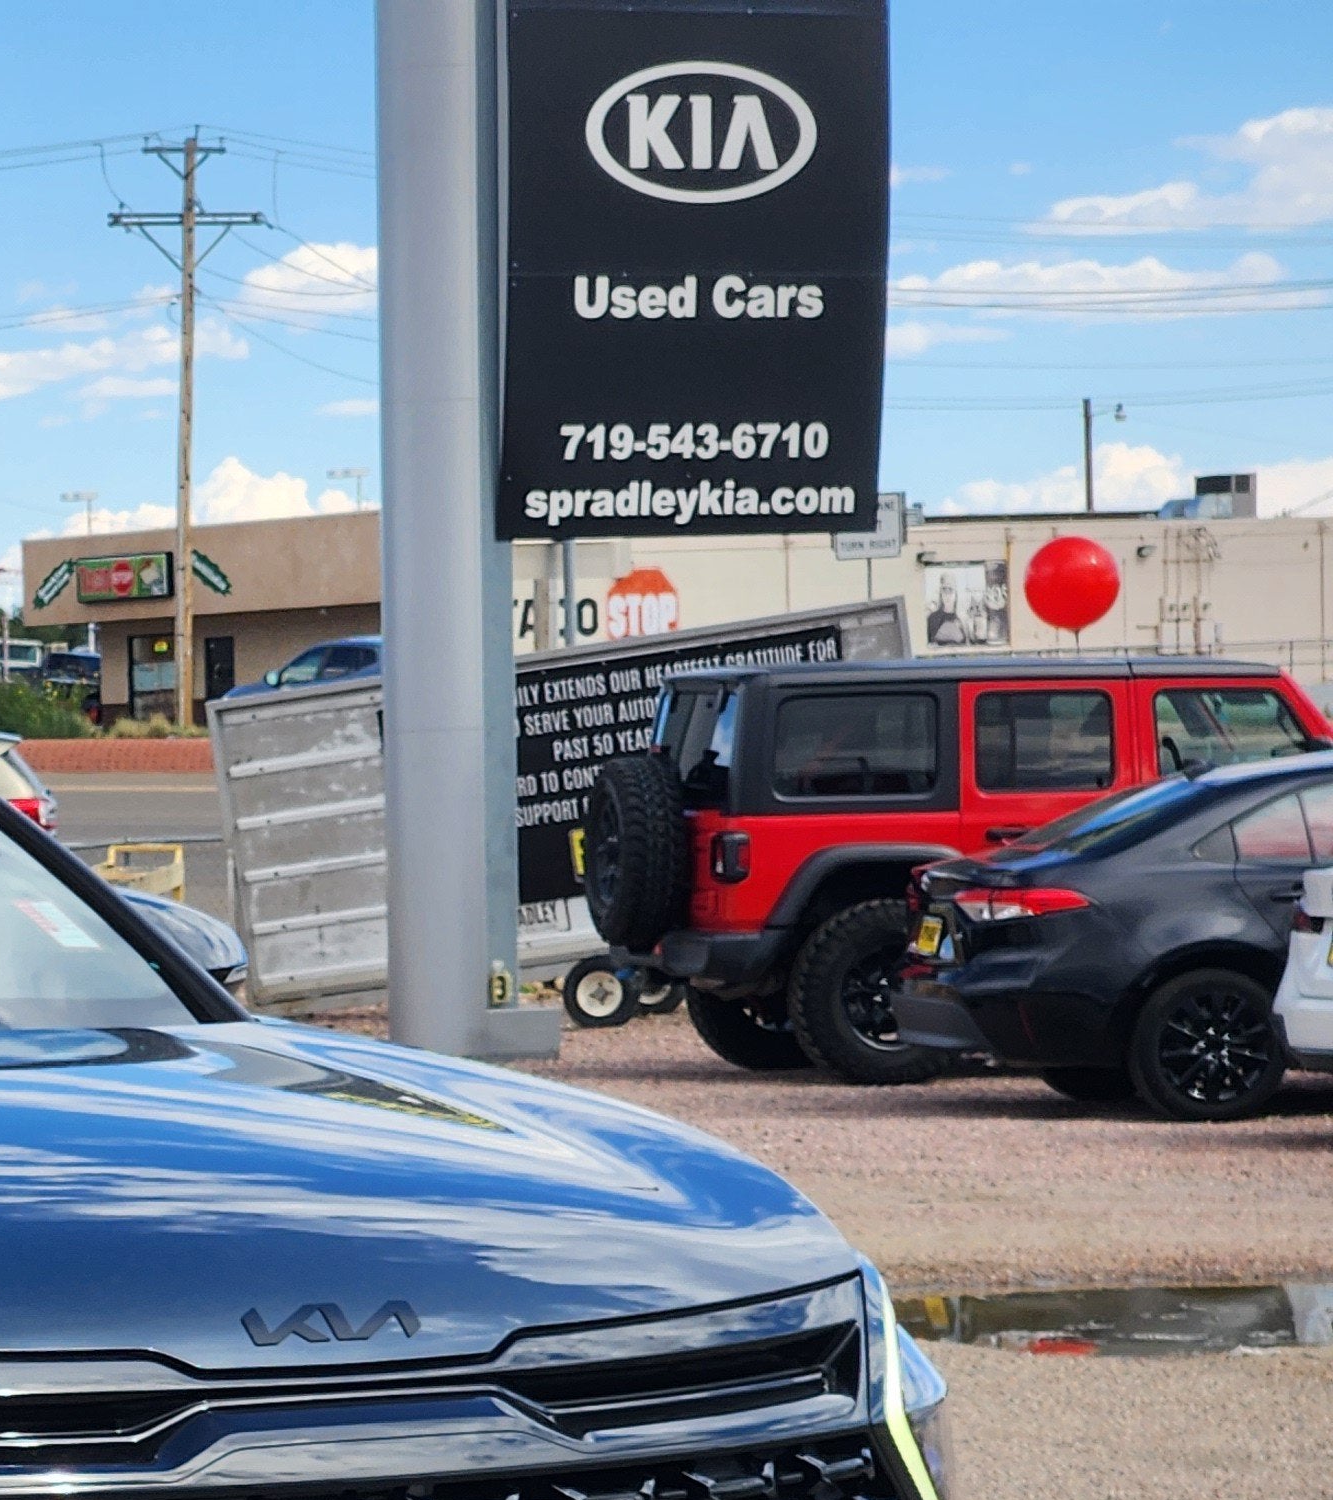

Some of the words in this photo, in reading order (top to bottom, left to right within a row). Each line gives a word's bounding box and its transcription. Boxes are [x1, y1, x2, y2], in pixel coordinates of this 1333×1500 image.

[627, 94, 779, 170] KIA
[574, 275, 697, 319] Used
[712, 275, 825, 319] Cars
[559, 423, 830, 461] 719-543-6710
[524, 480, 856, 526] spradleykia.com
[608, 593, 676, 639] STOP
[543, 673, 607, 703] EXTENDS
[609, 667, 642, 694] OUR
[808, 636, 838, 664] FOR
[523, 709, 571, 737] SERVE
[573, 702, 615, 729] YOUR
[552, 734, 590, 762] PAST
[592, 732, 615, 757] 50
[540, 770, 560, 794] TO
[515, 797, 580, 828] SUPPORT
[240, 1299, 422, 1347] KIA
